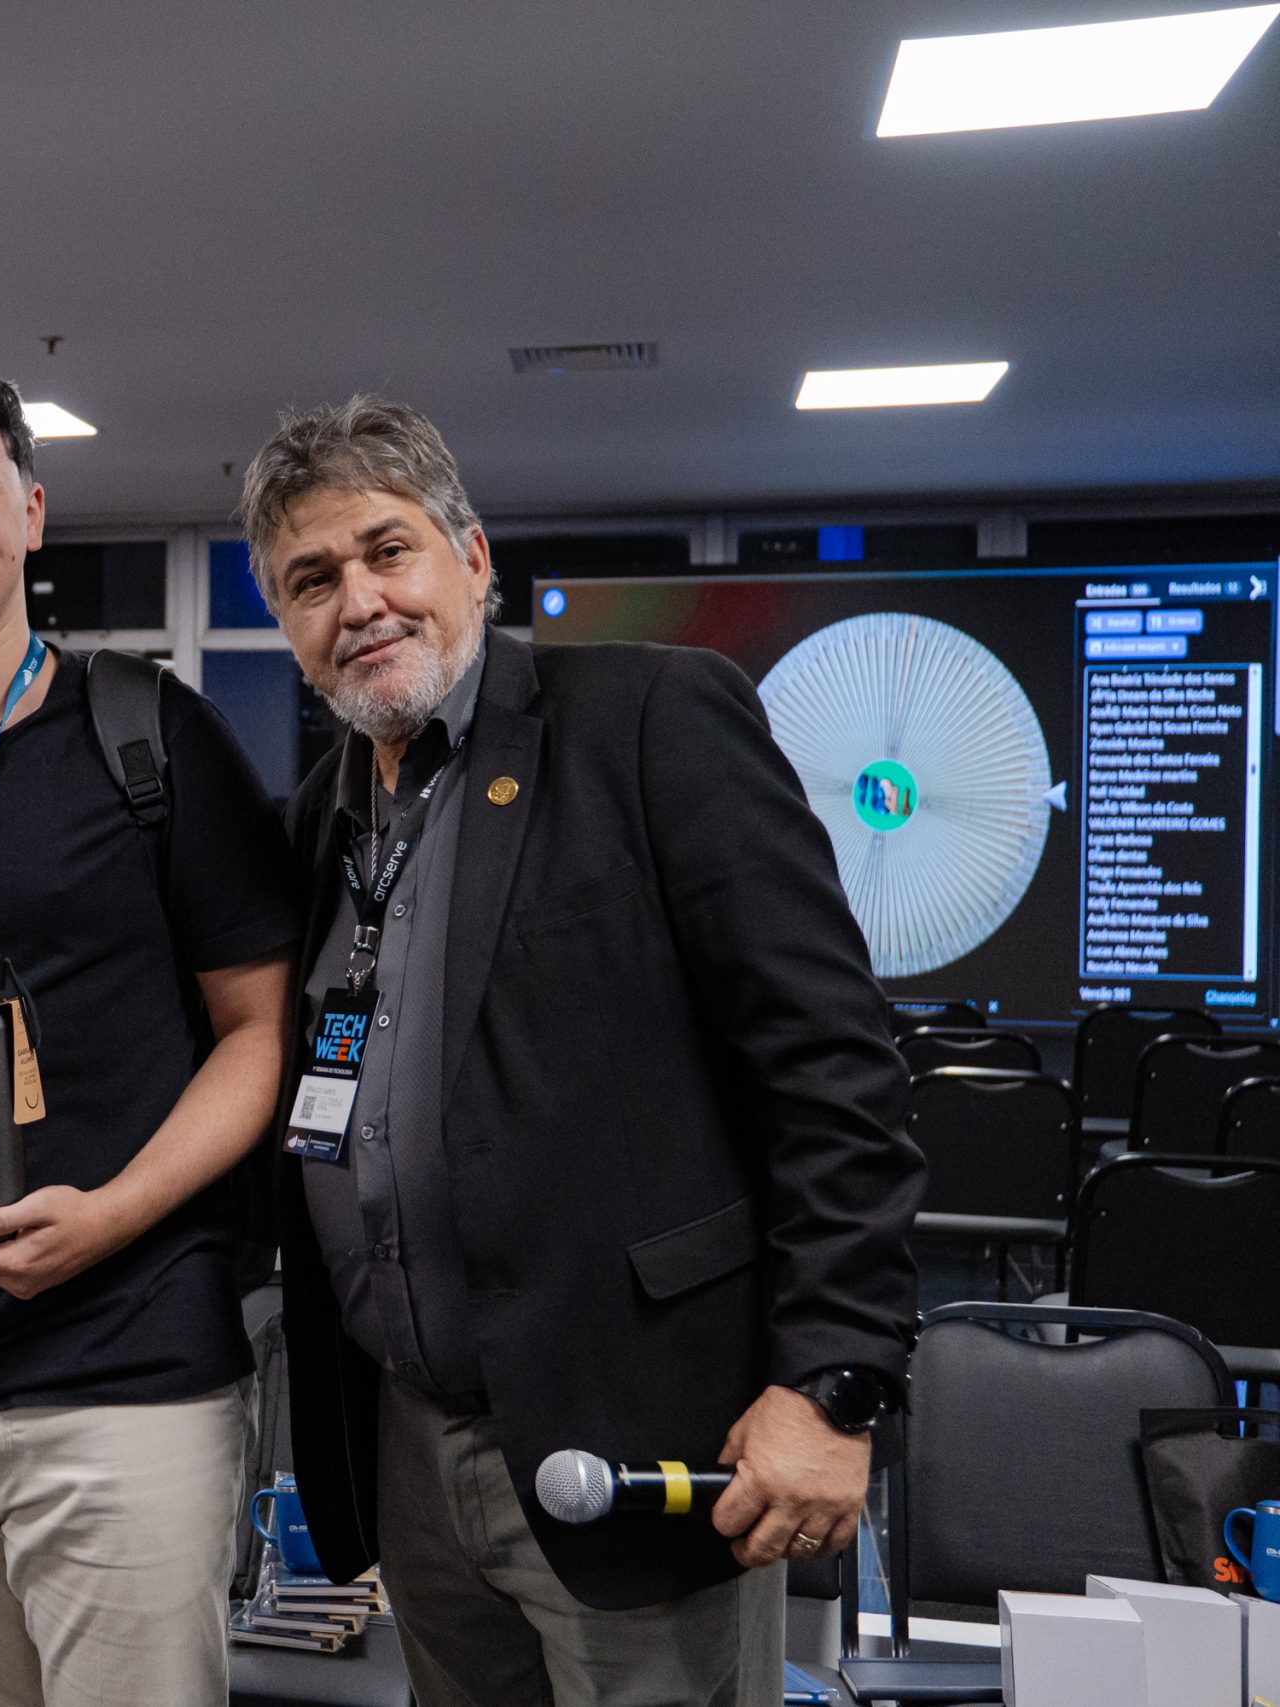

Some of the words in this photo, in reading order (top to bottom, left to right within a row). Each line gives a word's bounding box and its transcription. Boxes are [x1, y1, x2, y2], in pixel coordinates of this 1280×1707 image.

[374, 840, 407, 902] arcserve
[324, 1013, 367, 1037] TECH
[315, 1036, 364, 1062] WEEK
